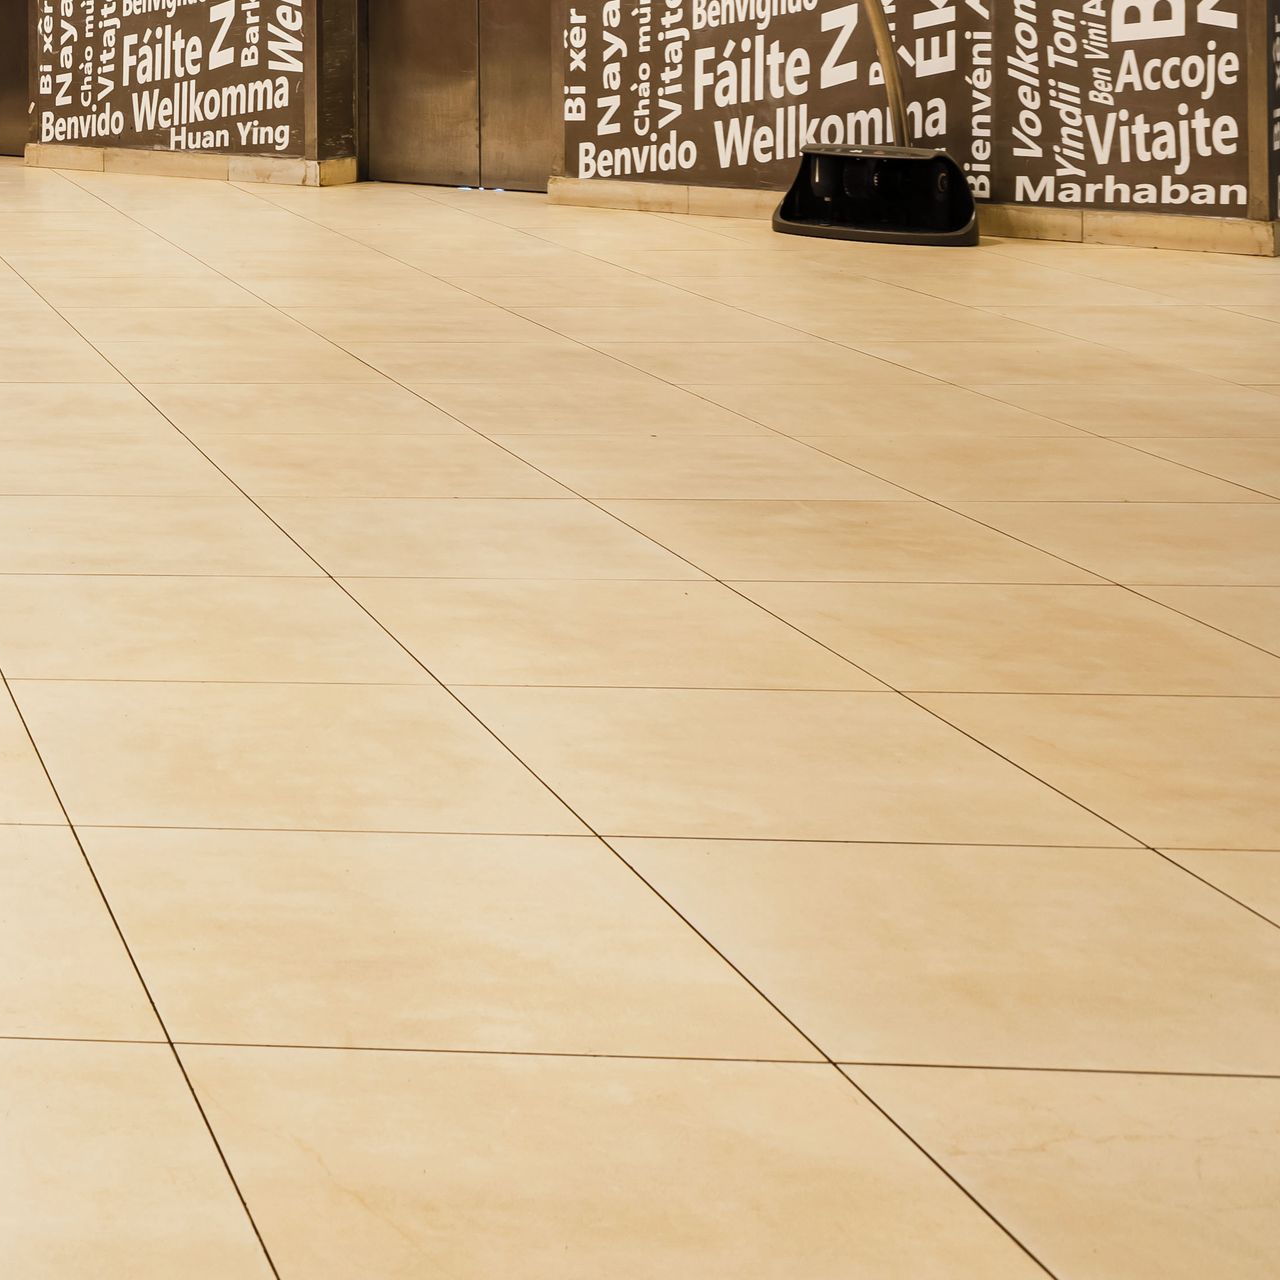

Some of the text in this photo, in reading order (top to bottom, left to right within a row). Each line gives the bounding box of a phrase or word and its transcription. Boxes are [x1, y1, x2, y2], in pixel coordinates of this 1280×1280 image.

[122, 25, 203, 87] Fáilte
[1047, 9, 1078, 70] Ton
[1084, 21, 1114, 106] Ben Vini
[40, 66, 52, 95] Bi
[694, 35, 809, 110] Fáilte
[1115, 40, 1239, 100] Accoje
[41, 102, 124, 142] Benvido
[132, 76, 289, 133] Wellkomma
[564, 85, 587, 121] Bi
[965, 30, 992, 199] Bienvéni
[1048, 78, 1087, 178] Yindii
[170, 121, 289, 151] Huan Ying
[578, 130, 697, 179] Benvido
[1085, 103, 1238, 175] Vitajte
[1015, 175, 1247, 205] Marhaban
